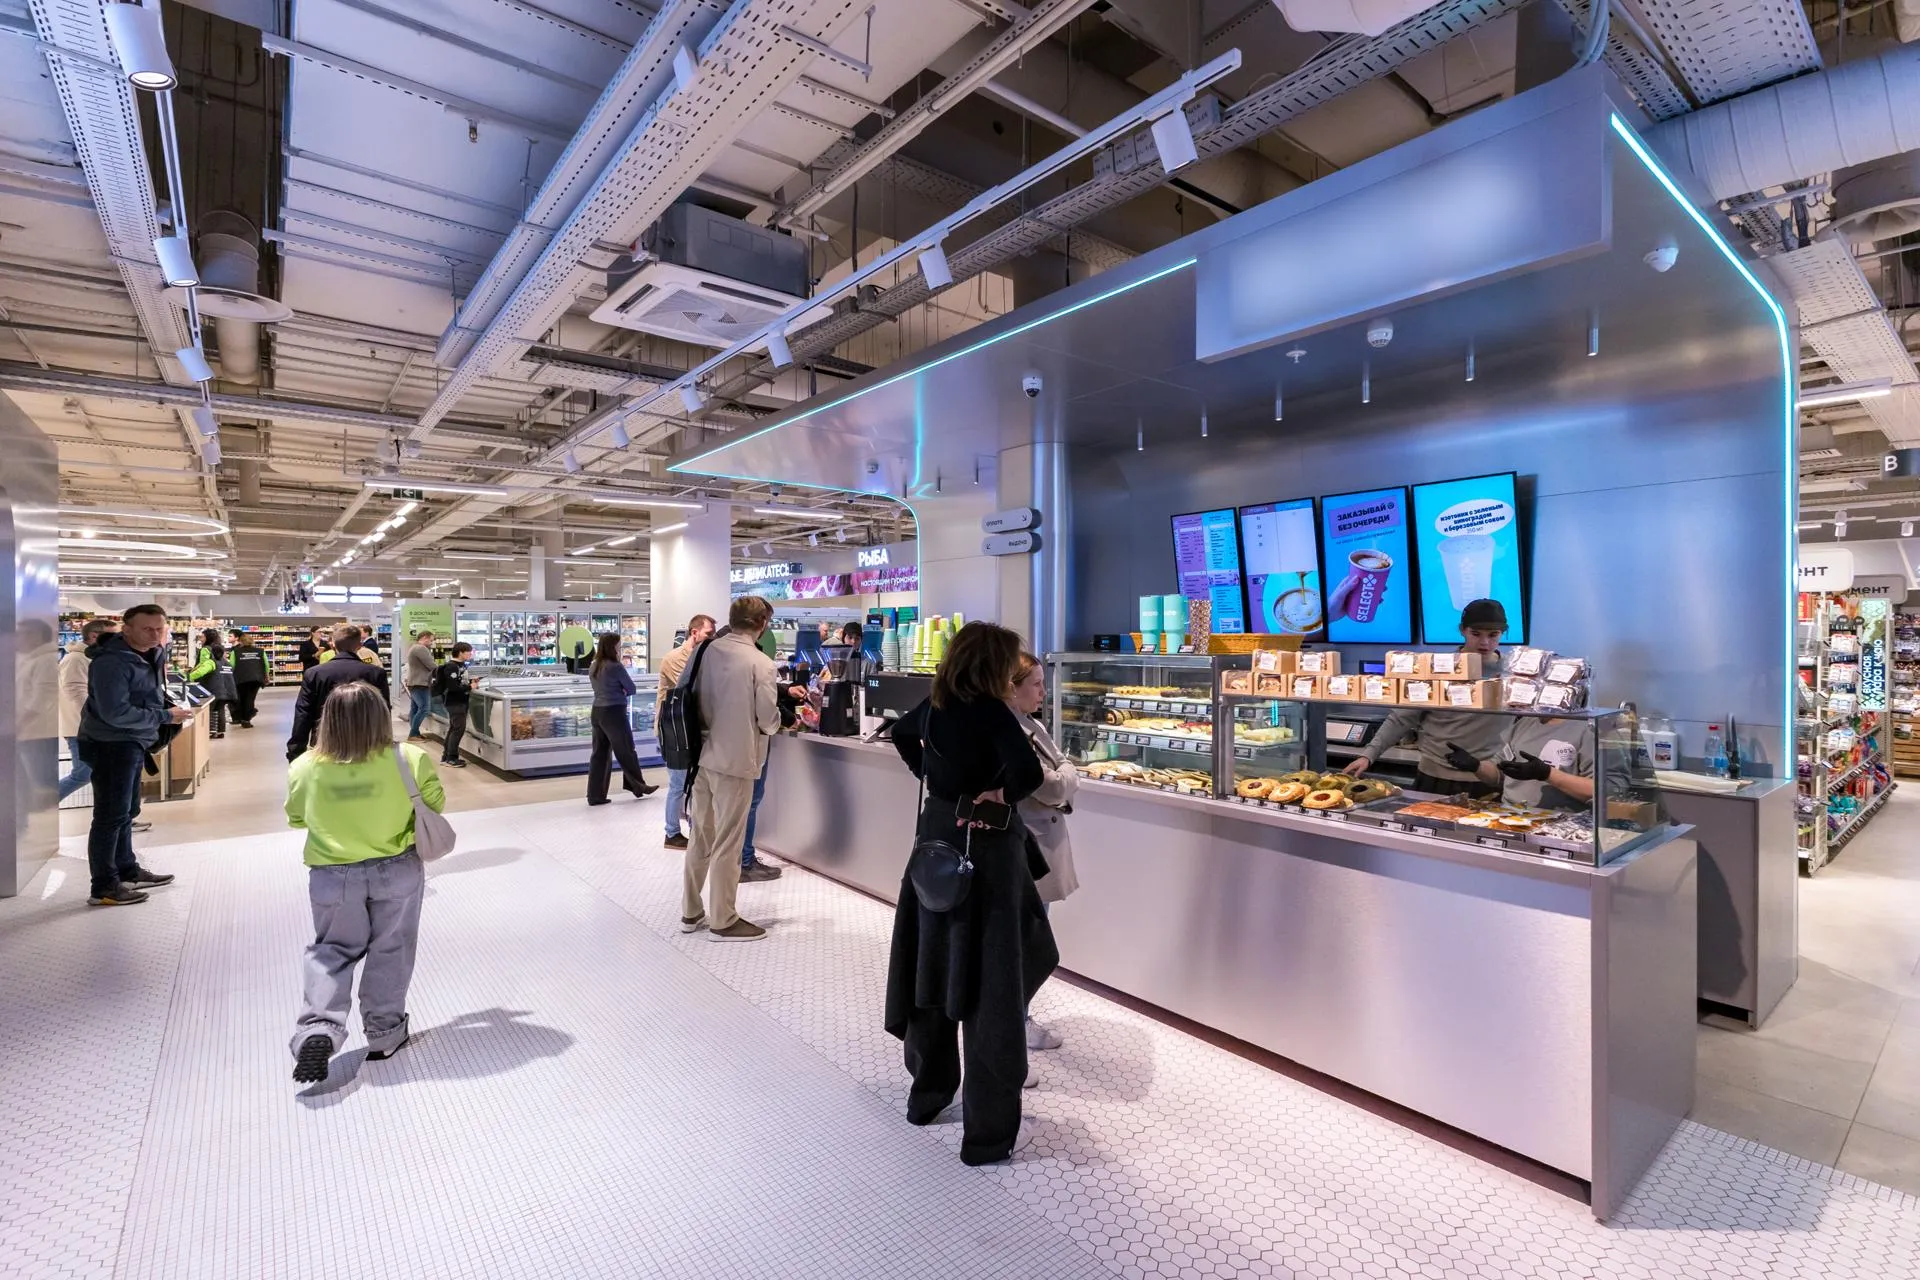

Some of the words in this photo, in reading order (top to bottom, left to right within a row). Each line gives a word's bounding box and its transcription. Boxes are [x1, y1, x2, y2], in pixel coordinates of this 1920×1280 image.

[1336, 503, 1387, 521] ЗАКАЗЫВАЙ
[1453, 512, 1492, 524] виноградом
[1474, 504, 1504, 514] зеленым
[1337, 522, 1352, 532] БЕЗ
[1353, 514, 1390, 528] ОЧЕРЕДИ
[1485, 515, 1505, 524] соком
[858, 548, 889, 568] РЫБА
[1356, 583, 1375, 622] SELECT
[1862, 655, 1873, 694] вкусная
